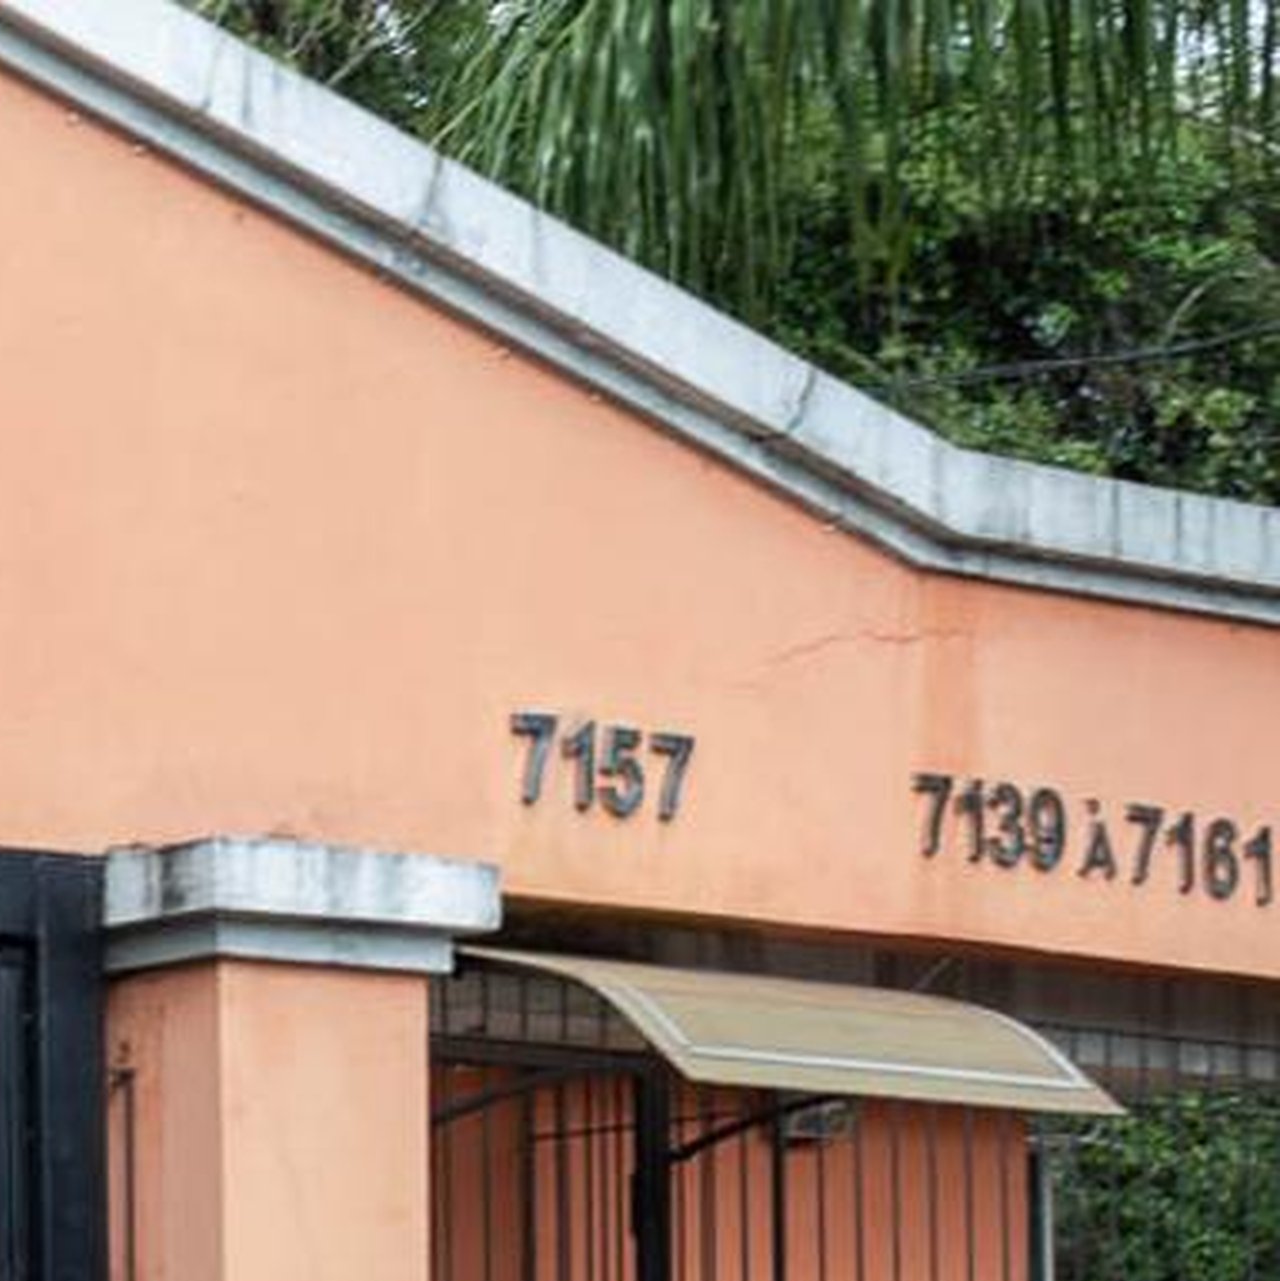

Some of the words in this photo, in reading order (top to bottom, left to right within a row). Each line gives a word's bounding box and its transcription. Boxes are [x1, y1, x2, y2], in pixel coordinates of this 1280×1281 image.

[510, 712, 697, 824] 7157
[911, 772, 1068, 875] 7139
[1125, 802, 1276, 908] 7161
